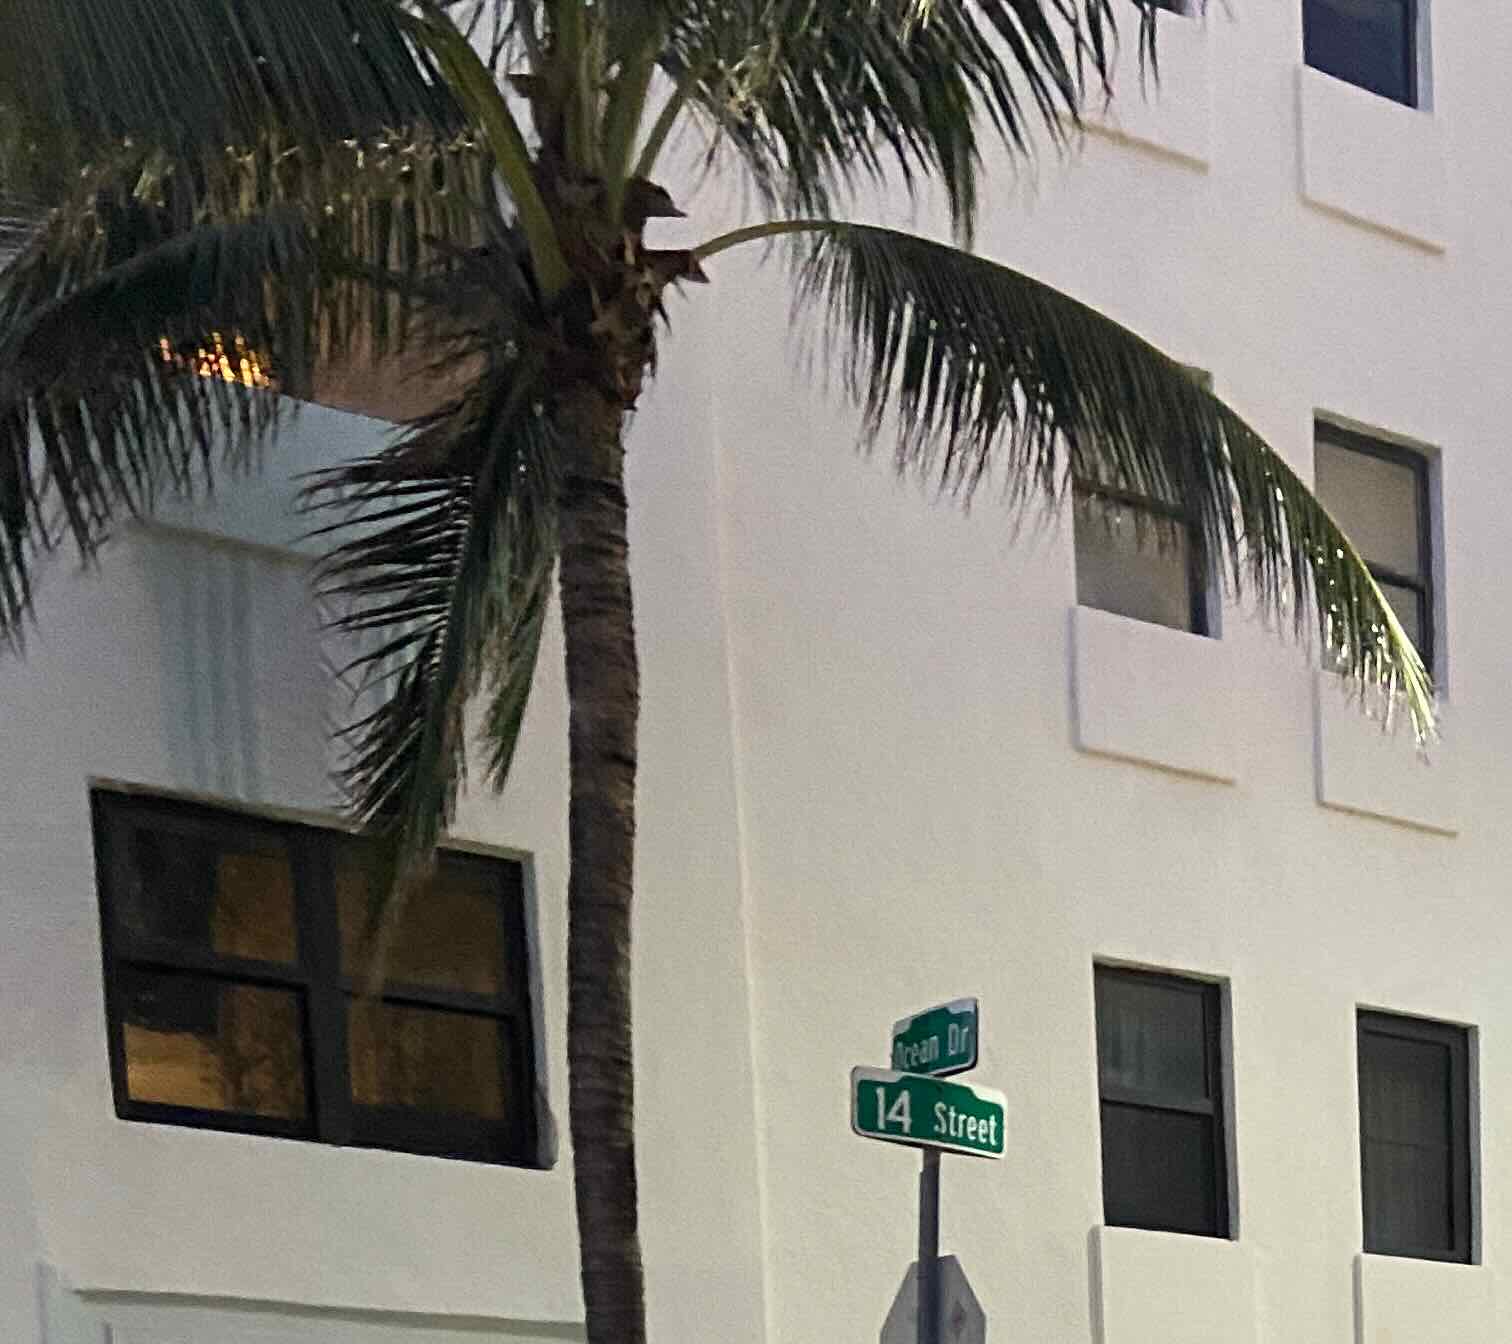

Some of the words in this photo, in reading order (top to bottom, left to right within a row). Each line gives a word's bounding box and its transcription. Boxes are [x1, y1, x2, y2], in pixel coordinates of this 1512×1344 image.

[895, 1036, 939, 1067] Ocean
[948, 1023, 969, 1056] Dr
[875, 1087, 912, 1134] 14
[934, 1102, 997, 1146] Street
